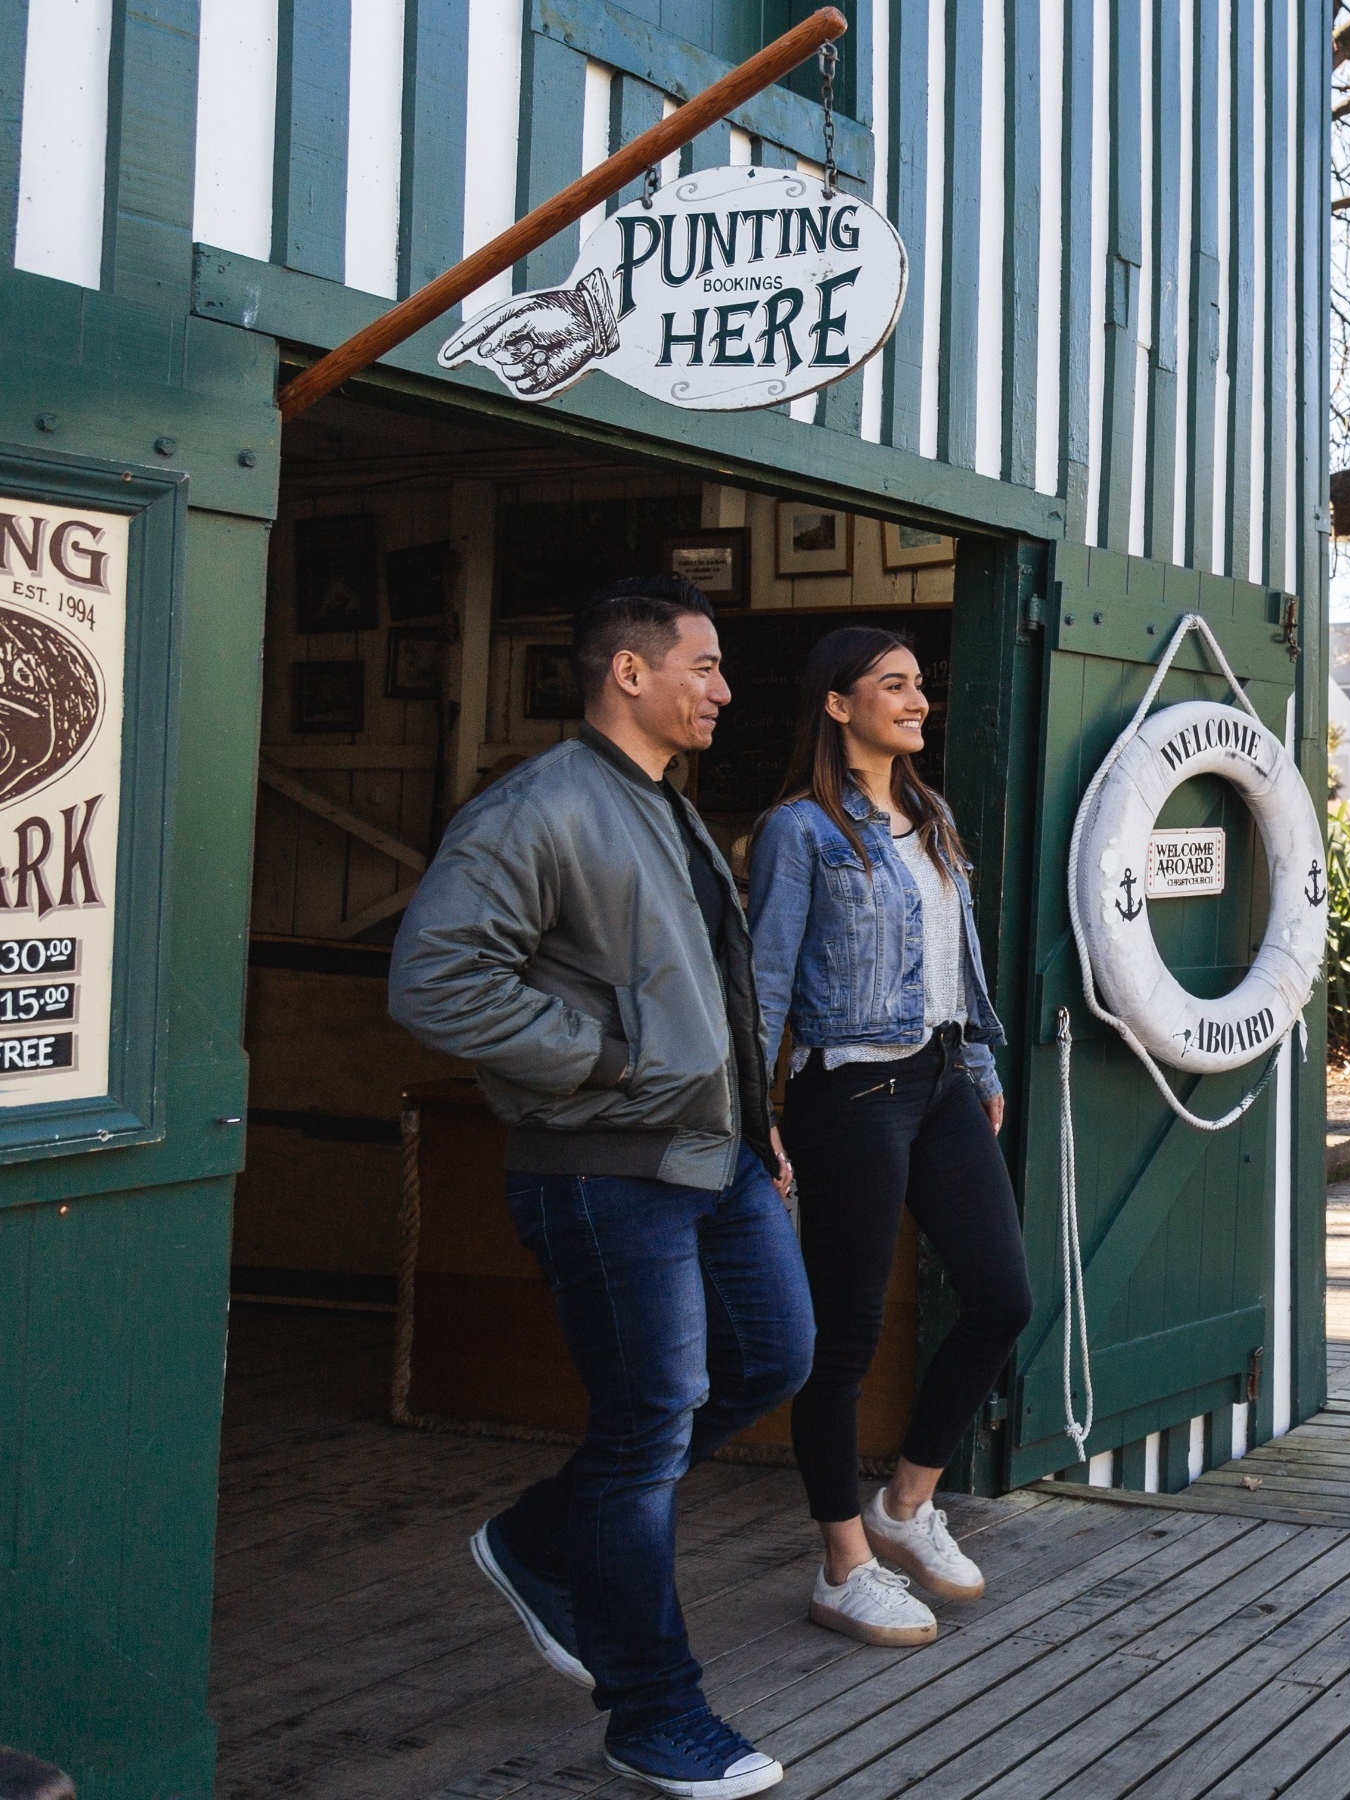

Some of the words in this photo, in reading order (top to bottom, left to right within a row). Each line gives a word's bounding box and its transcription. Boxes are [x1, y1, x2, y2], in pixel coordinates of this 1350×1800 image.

[612, 204, 861, 323] PUNTING
[703, 275, 784, 293] BOOKINGS
[655, 265, 863, 376] HERE
[12, 581, 49, 606] EST.
[58, 592, 96, 632] 1994
[1160, 718, 1261, 772] WELCOME
[1156, 842, 1214, 858] WELCOME
[1156, 857, 1214, 880] ABOARD
[0, 1036, 56, 1069] REE
[1189, 1007, 1274, 1055] ABOARD
